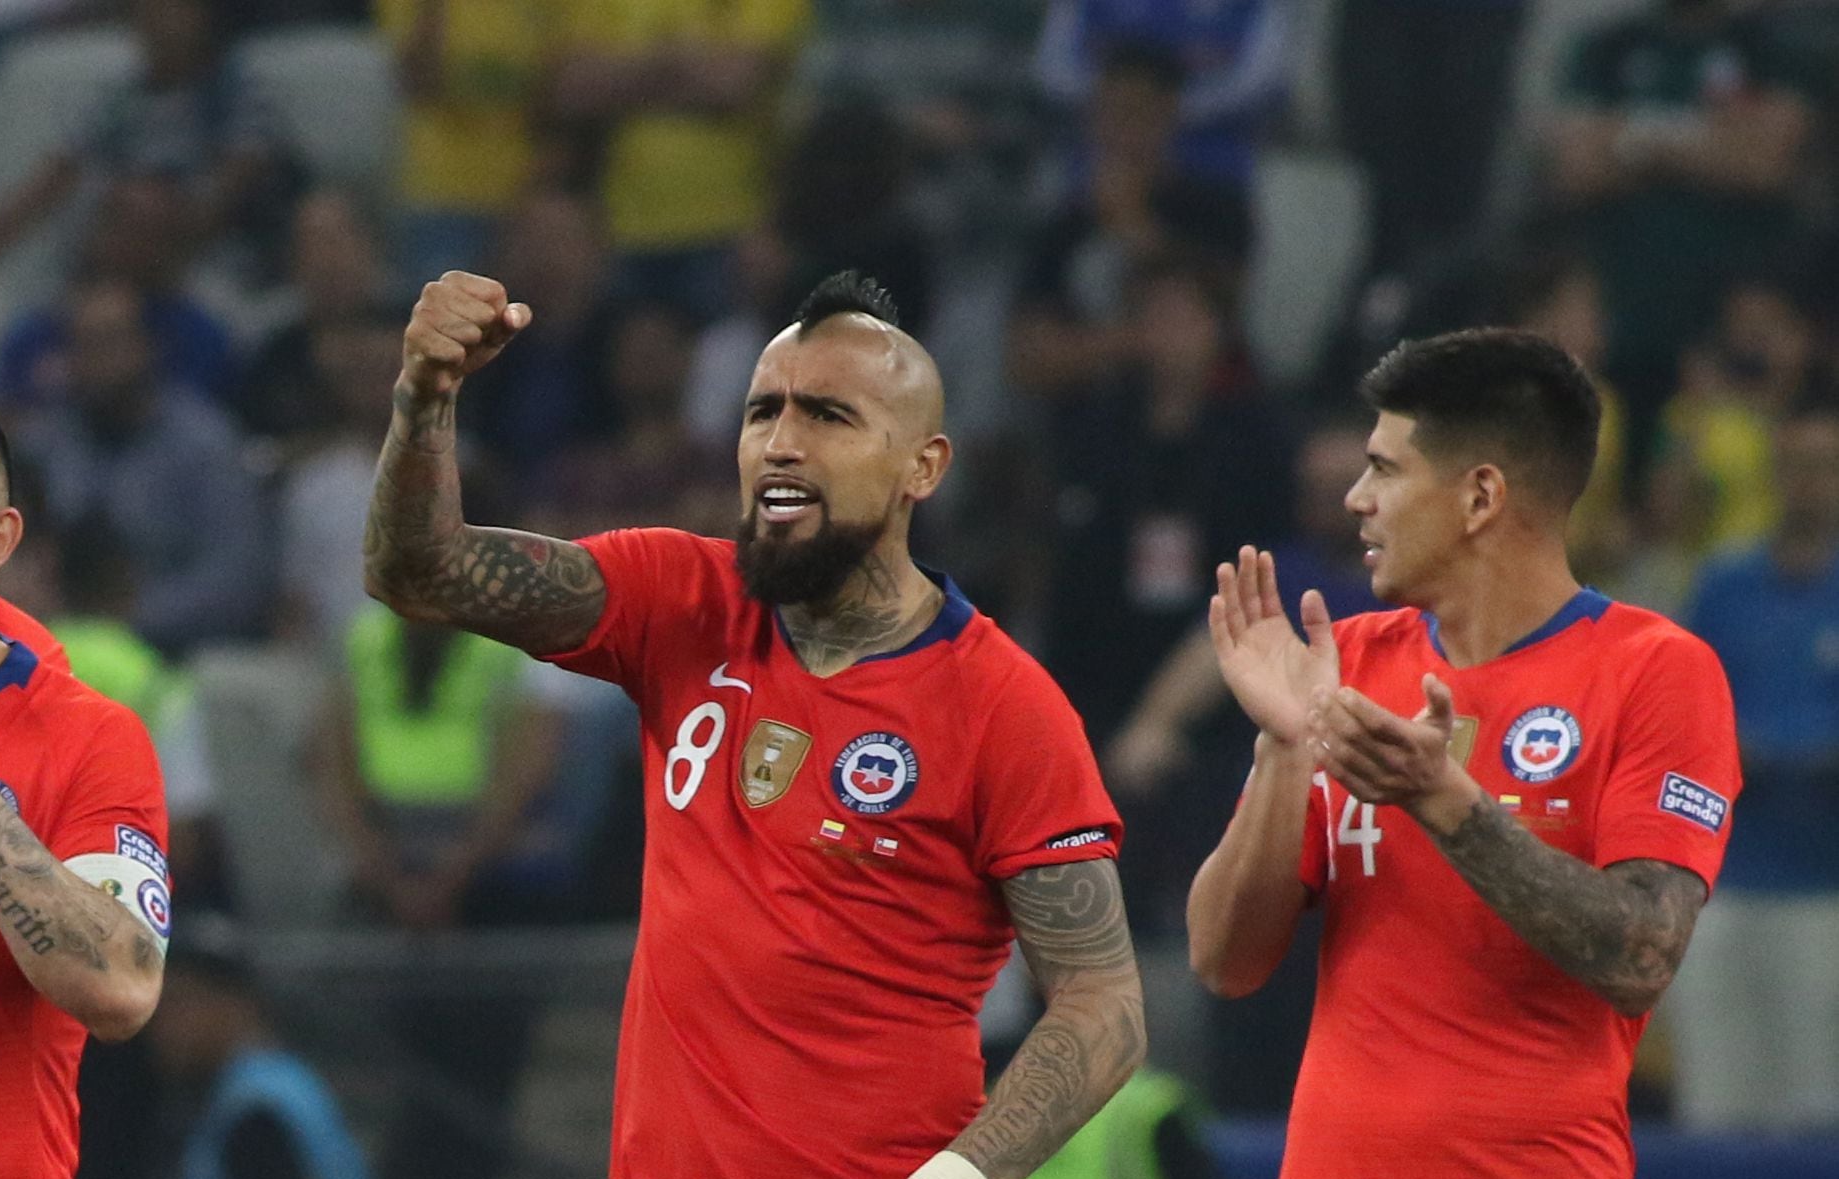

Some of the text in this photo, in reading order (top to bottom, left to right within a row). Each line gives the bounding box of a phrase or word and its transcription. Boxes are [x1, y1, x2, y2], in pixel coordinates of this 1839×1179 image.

[665, 702, 726, 810] 8
[1664, 794, 1719, 826] grande
[1668, 778, 1723, 815] Cree en
